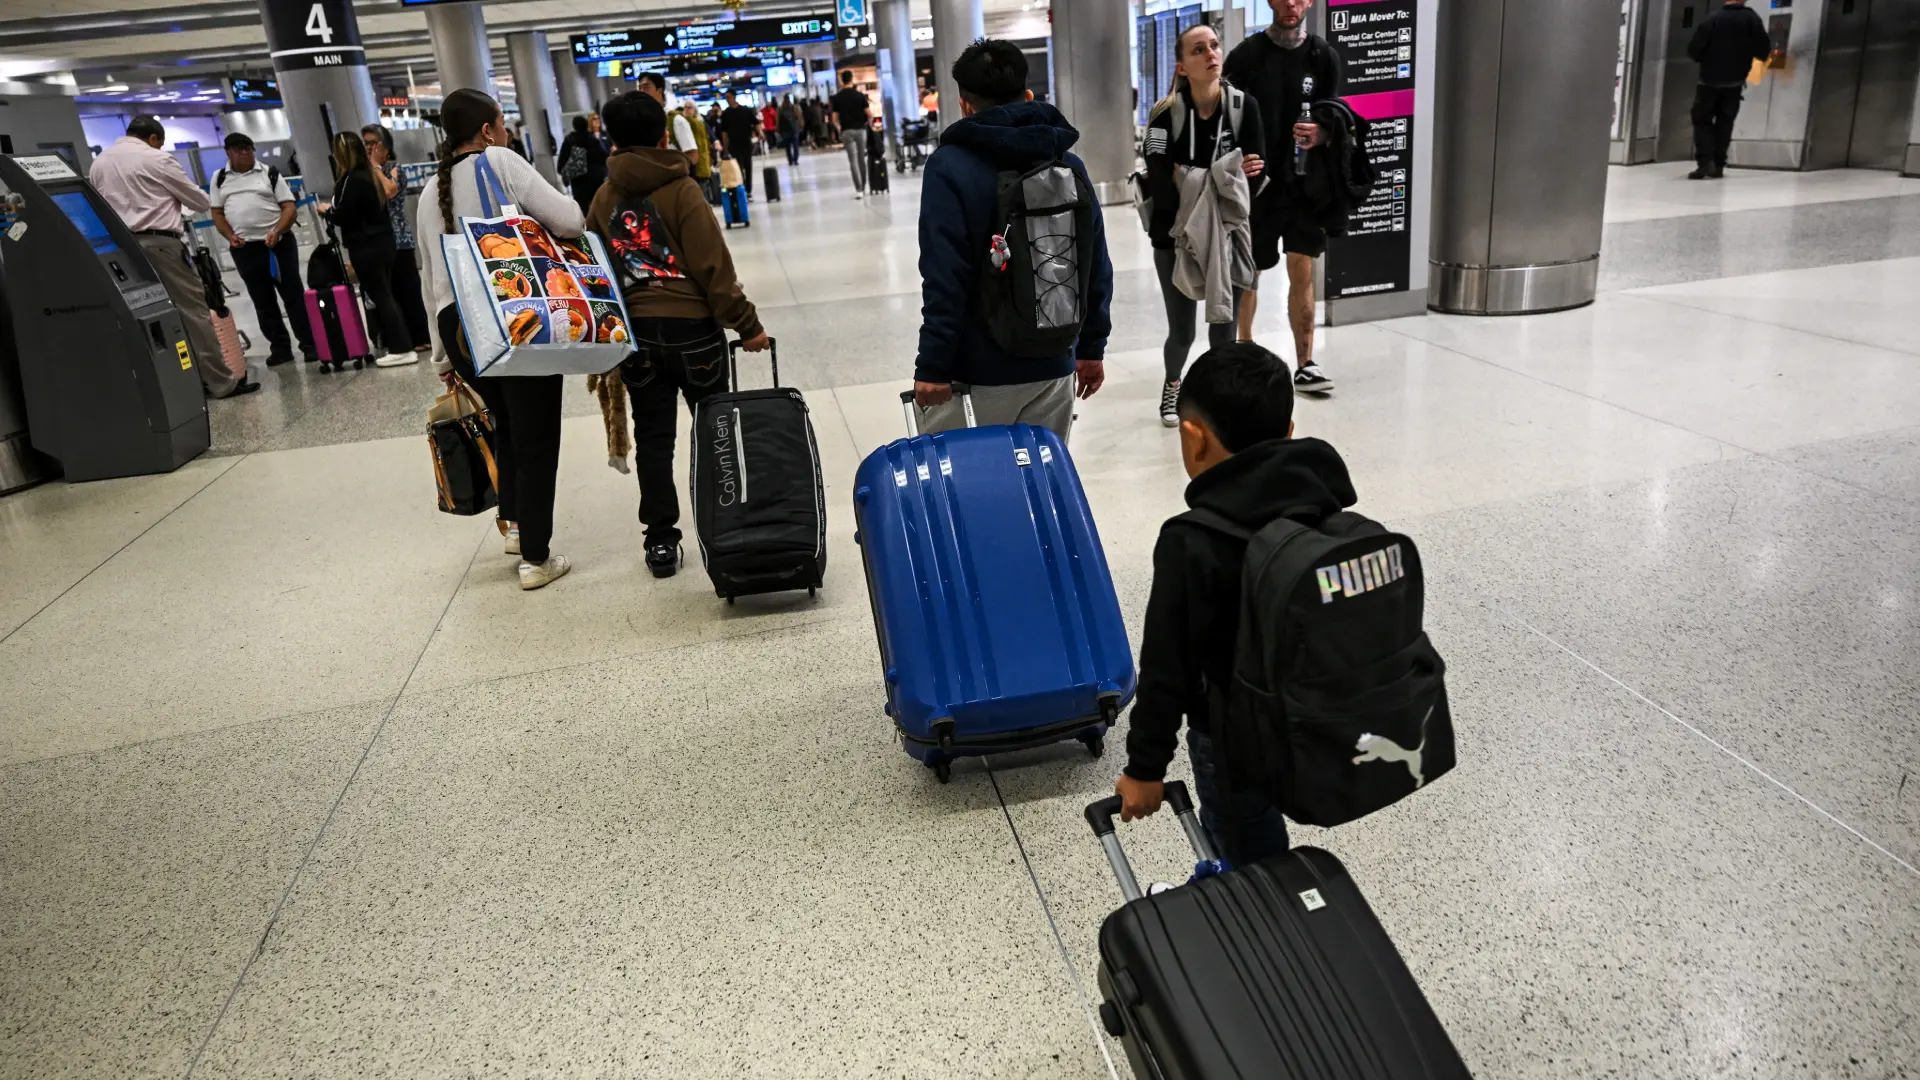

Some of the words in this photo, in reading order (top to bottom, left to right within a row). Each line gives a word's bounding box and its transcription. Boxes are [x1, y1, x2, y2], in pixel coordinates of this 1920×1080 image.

[1350, 14, 1366, 24] MIA
[1369, 12, 1395, 22] Mover
[1396, 10, 1409, 19] To:
[305, 3, 333, 44] 4
[782, 22, 808, 35] EXIT
[1338, 34, 1360, 42] Rental
[1368, 48, 1398, 57] Metrorail
[314, 55, 342, 66] MAIN
[1365, 67, 1396, 75] Metrobus
[1376, 155, 1399, 163] Shuttle
[1380, 170, 1392, 178] Taxi
[1363, 220, 1391, 228] Megabus
[500, 261, 535, 282] JAMAICA
[510, 302, 544, 314] VIETNAM
[549, 300, 569, 310] PERU
[714, 414, 730, 452] Klein
[716, 453, 735, 507] Calvin
[1315, 543, 1404, 604] PUMA
